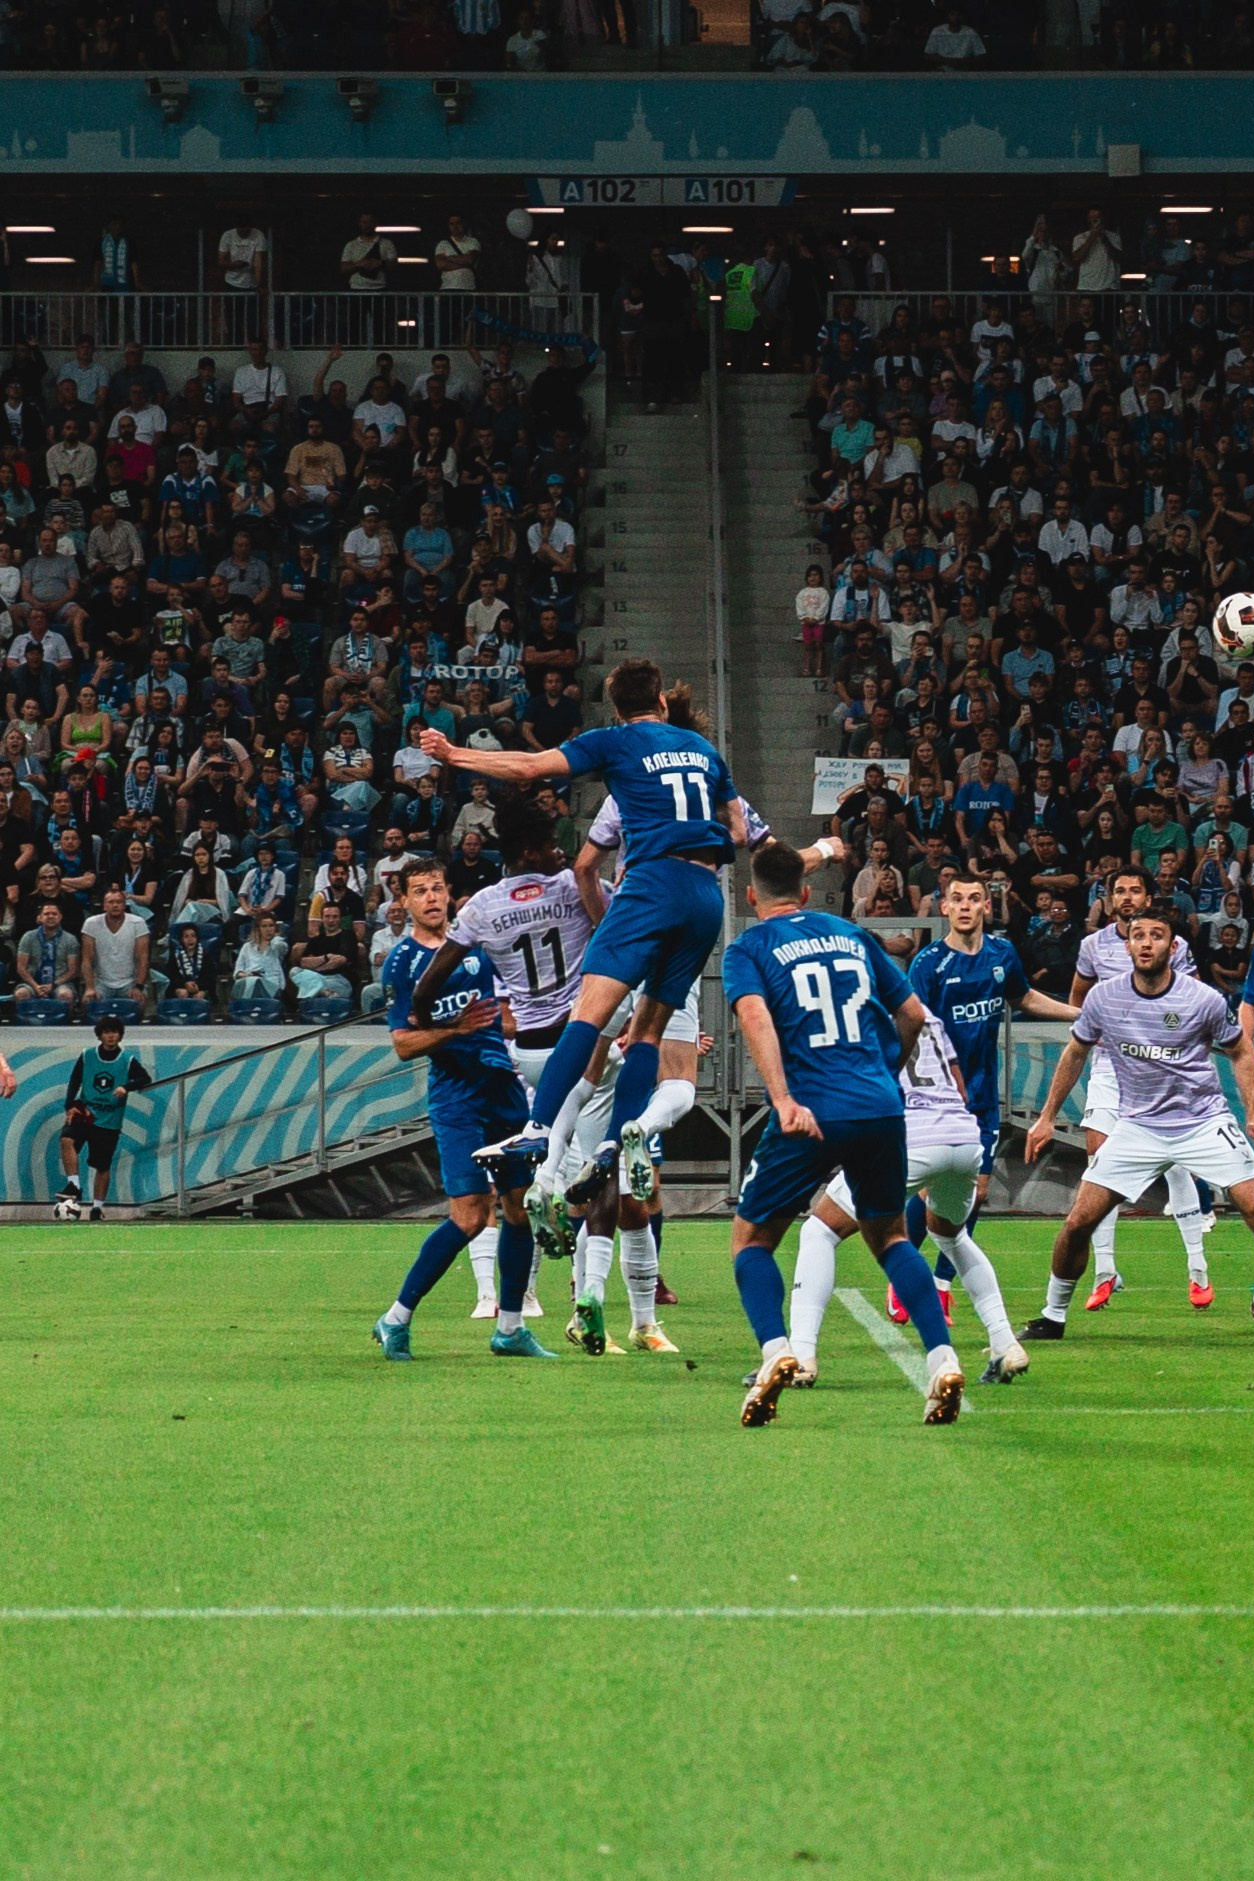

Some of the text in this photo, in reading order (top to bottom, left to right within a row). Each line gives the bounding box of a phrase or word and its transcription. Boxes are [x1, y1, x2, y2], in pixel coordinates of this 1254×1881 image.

[563, 179, 637, 203] A 102
[688, 179, 756, 203] A 101
[613, 444, 628, 456] 17
[612, 482, 627, 494] 16
[612, 521, 627, 534] 15
[612, 561, 627, 573] 14
[613, 600, 627, 613] 13
[613, 639, 628, 651] 12
[812, 680, 829, 692] 12
[816, 714, 829, 726] 11
[660, 772, 712, 822] 11
[491, 903, 574, 934] БЕНШИМОЛ
[772, 934, 867, 966] ПОКИДЫШЕВ
[512, 926, 568, 996] 11
[430, 988, 482, 1018] ОТОР
[791, 958, 872, 1049] 97
[1119, 1042, 1183, 1061] FONBET
[1217, 1123, 1247, 1150] 19
